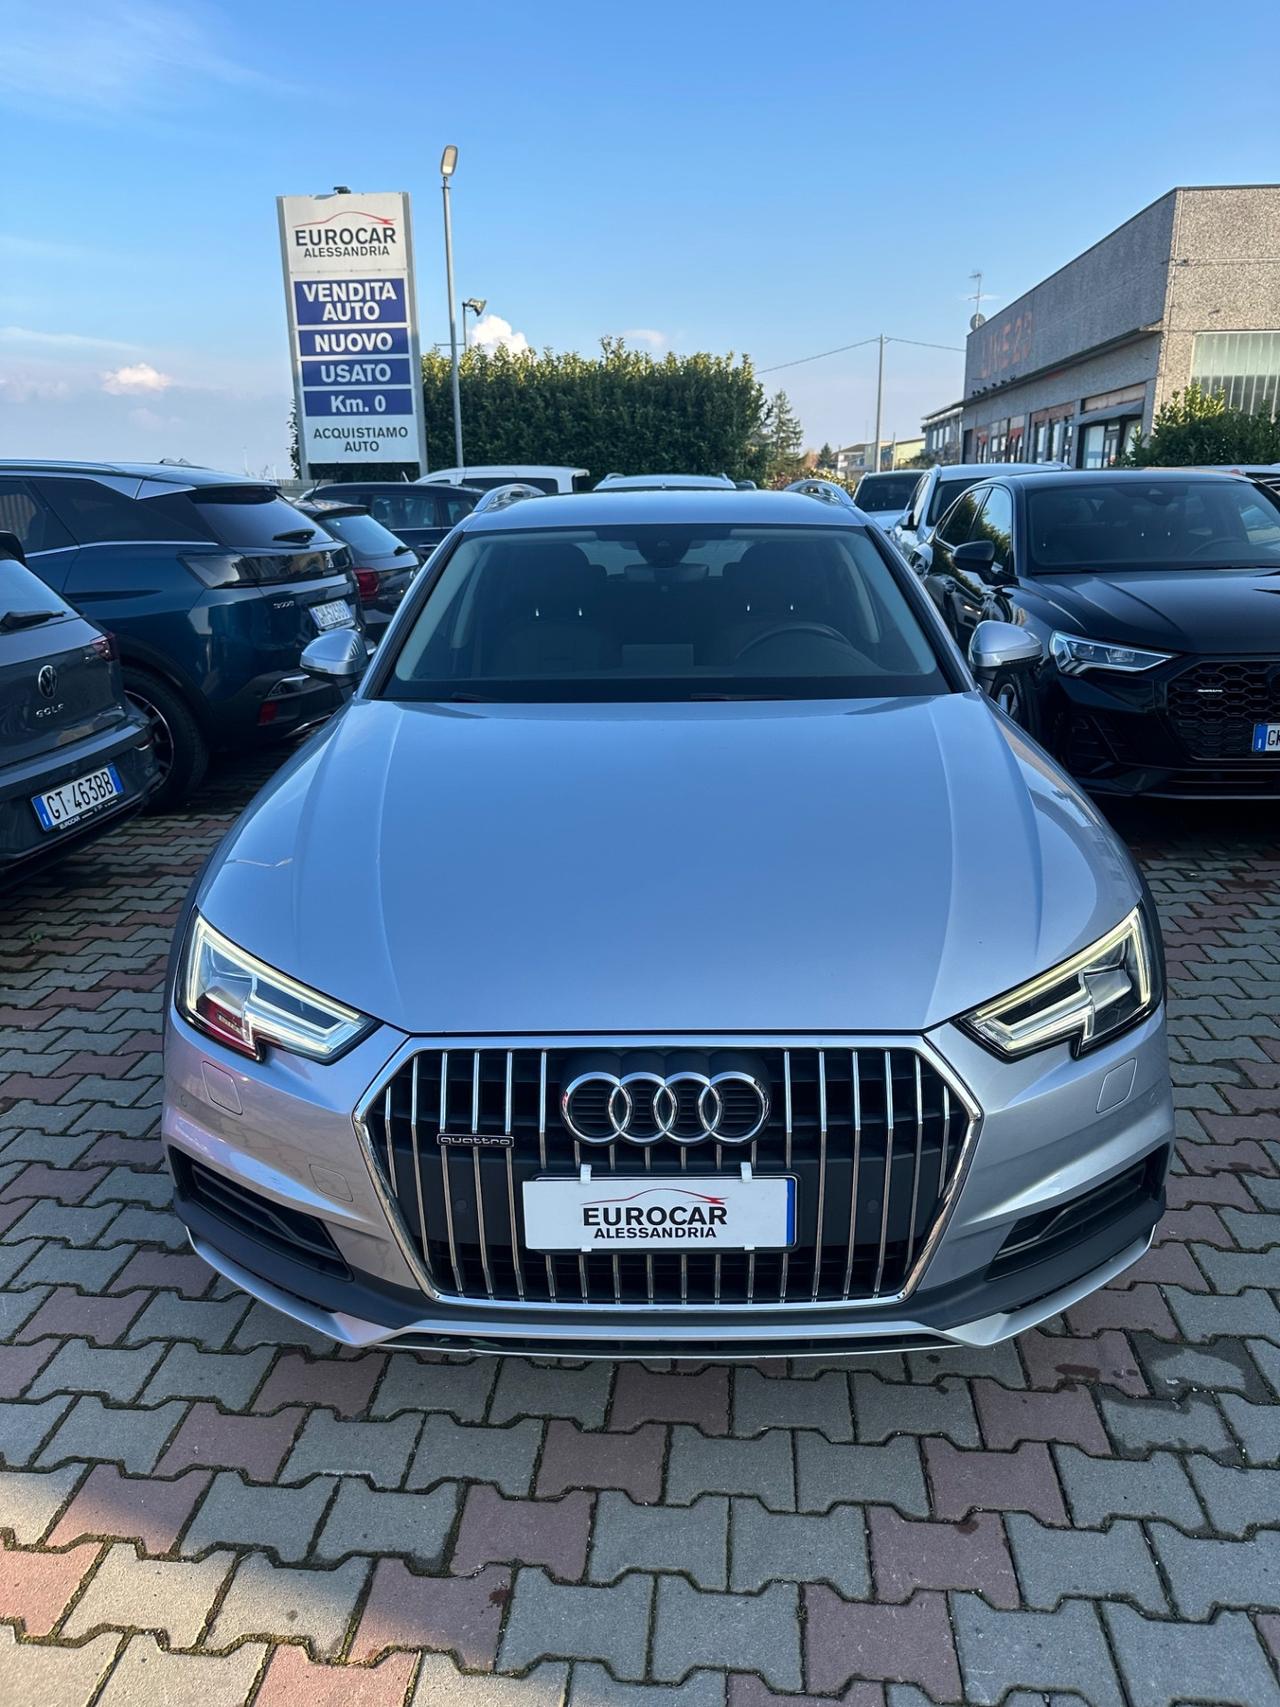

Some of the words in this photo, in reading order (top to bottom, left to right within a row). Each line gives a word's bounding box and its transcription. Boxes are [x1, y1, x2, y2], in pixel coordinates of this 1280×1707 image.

[295, 227, 396, 246] EUROCAR
[304, 245, 390, 258] ALESSANDRIA
[303, 282, 397, 302] VENDITA
[322, 302, 380, 321] AUTO
[314, 332, 393, 352] NUOVO
[320, 363, 391, 383] USATO
[330, 395, 369, 413] Km.
[374, 395, 386, 412] 0
[313, 426, 408, 439] ACQUISTIAMO
[344, 441, 379, 452] AUTO
[36, 703, 64, 718] GOLF
[46, 790, 69, 820] GT
[72, 771, 114, 809] 463BB
[440, 1136, 510, 1145] quattro
[583, 1206, 728, 1226] EUROCAR
[594, 1226, 717, 1239] ALESSANDRIA
